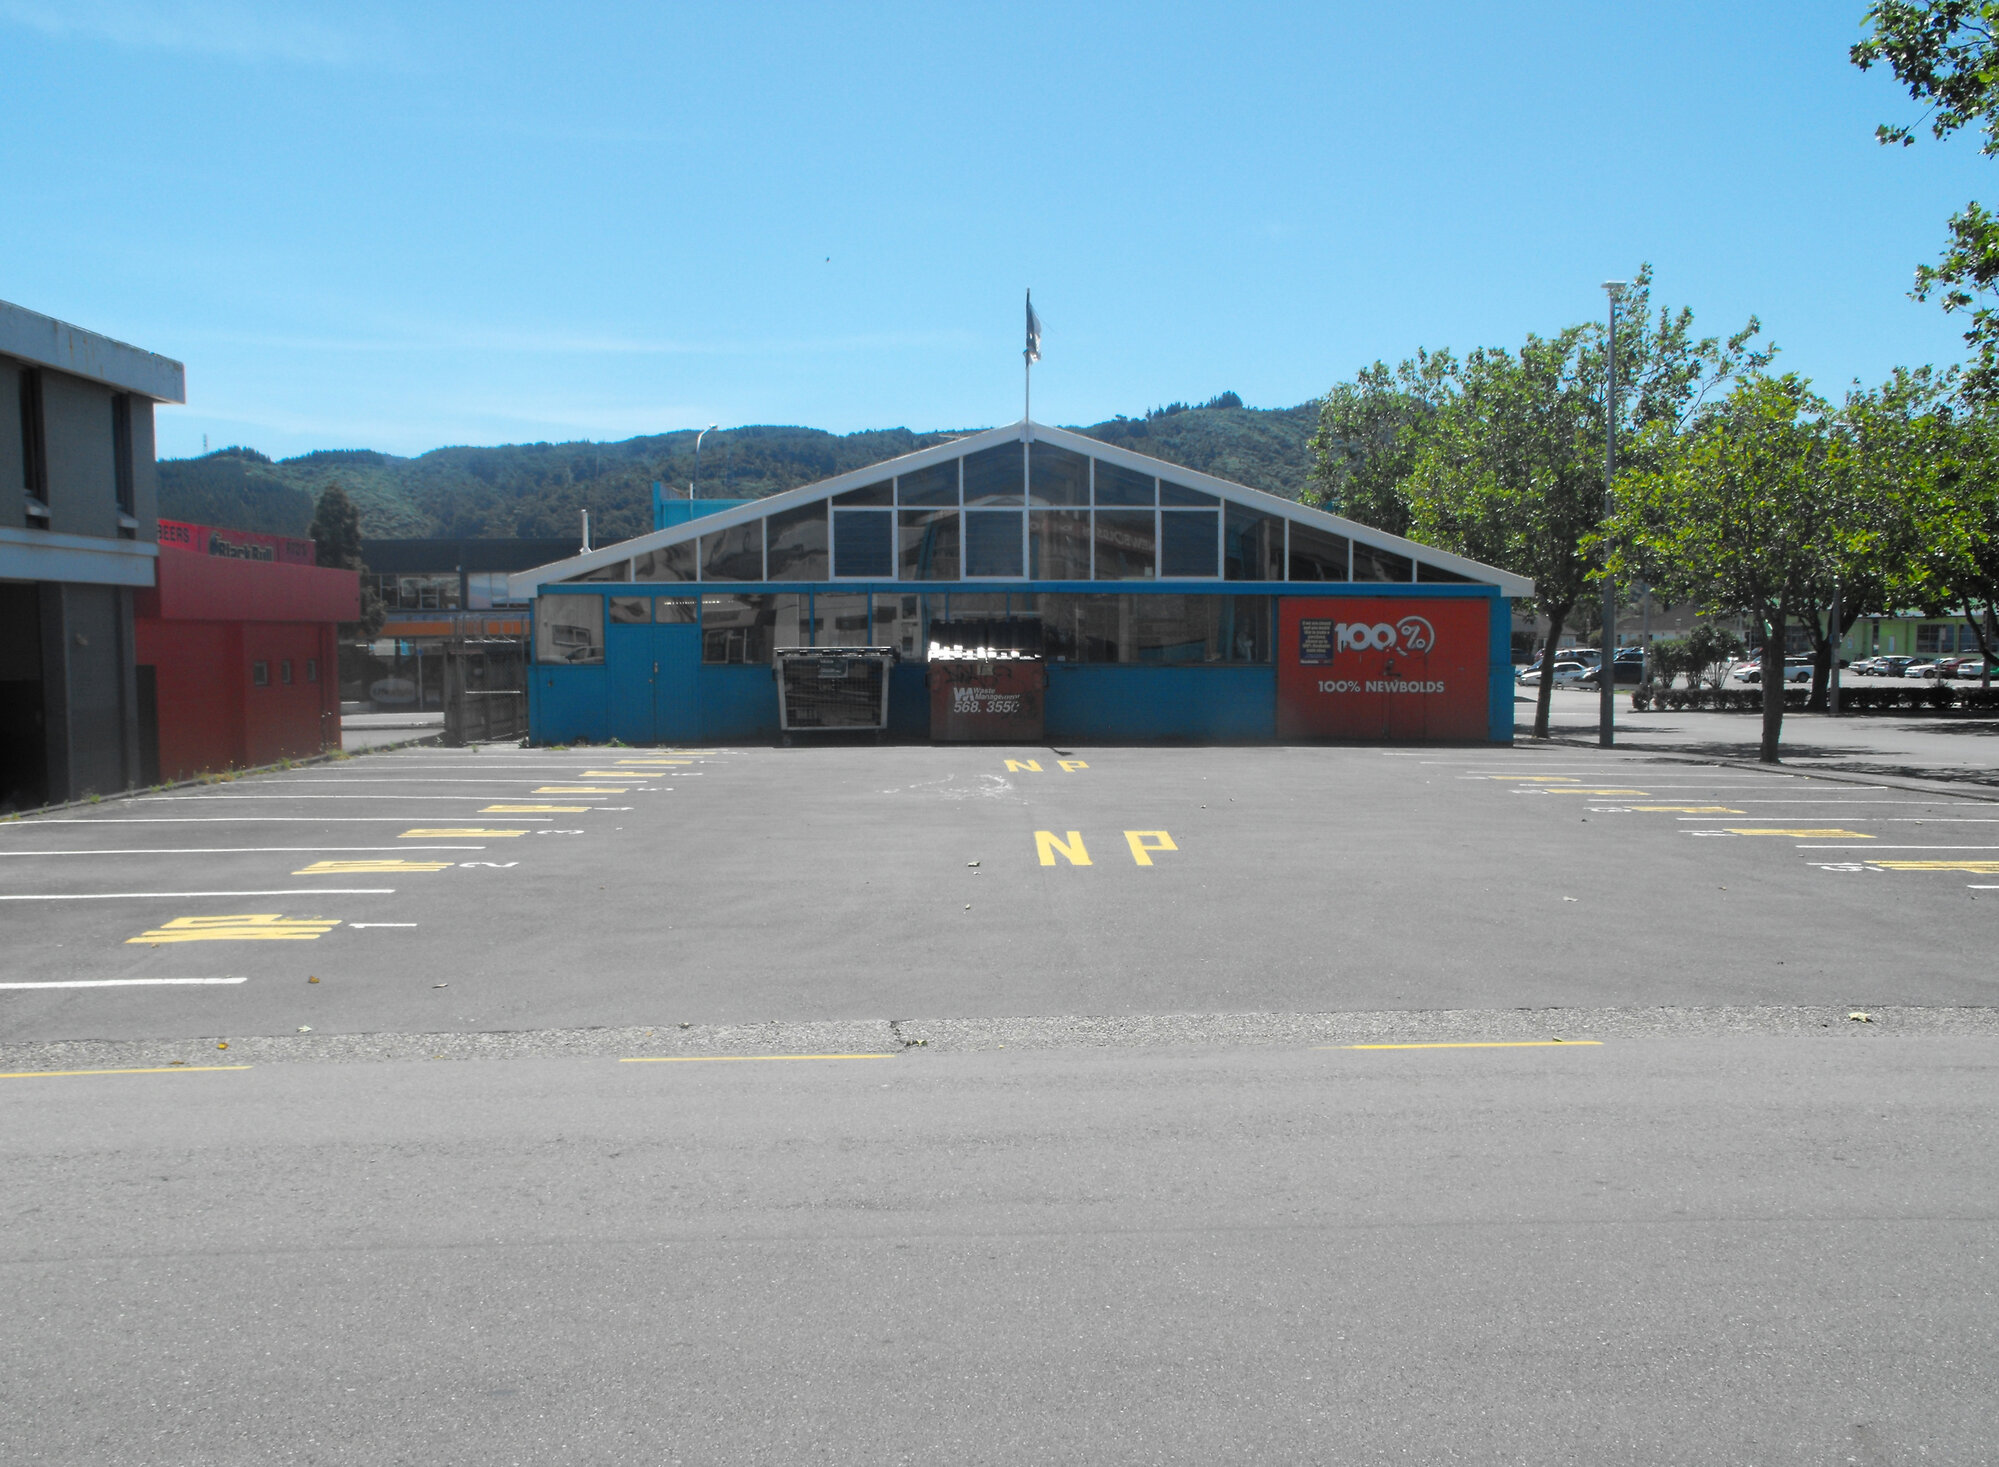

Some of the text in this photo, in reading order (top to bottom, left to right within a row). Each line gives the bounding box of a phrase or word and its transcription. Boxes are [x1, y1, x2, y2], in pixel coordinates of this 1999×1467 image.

[218, 540, 274, 563] Black Bull
[1318, 680, 1445, 693] 100% NEWBOLDS
[1033, 830, 1180, 867] N P
